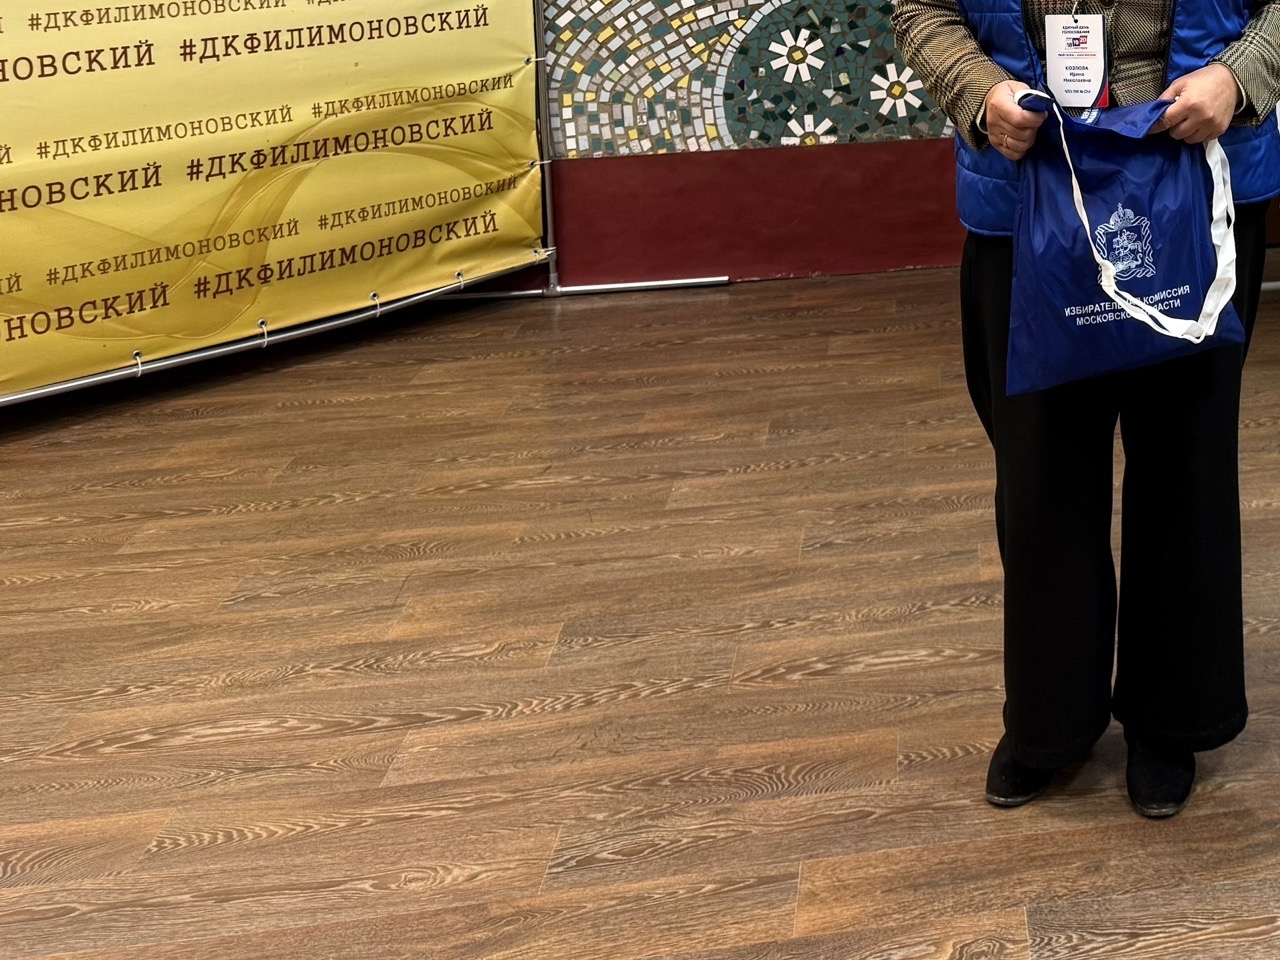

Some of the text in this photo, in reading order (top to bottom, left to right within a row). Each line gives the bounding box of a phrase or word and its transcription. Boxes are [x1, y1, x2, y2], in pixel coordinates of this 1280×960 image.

[179, 5, 489, 64] #ДКФИЛИМОНОВСКИЙ
[36, 105, 293, 160] #ДКФИЛИМОНОВСКИЙ
[311, 72, 514, 119] #ДКФИЛИМОНОВСКИЙ
[186, 109, 494, 182] #ДКФИЛИМОНОВСКИЙ
[46, 218, 299, 286] #ДКФИЛИМОНОВСКИЙ
[317, 174, 518, 231] #ДКФИЛИМОНОВСКИЙ
[4, 211, 499, 342] НОВСКИЙ #ДКФИЛИМОНОВСКИЙ
[1064, 284, 1191, 317] ИЗБИРАТЕЛЬ КОМИССИЯ
[1076, 311, 1132, 326] МОСКОВСКО
